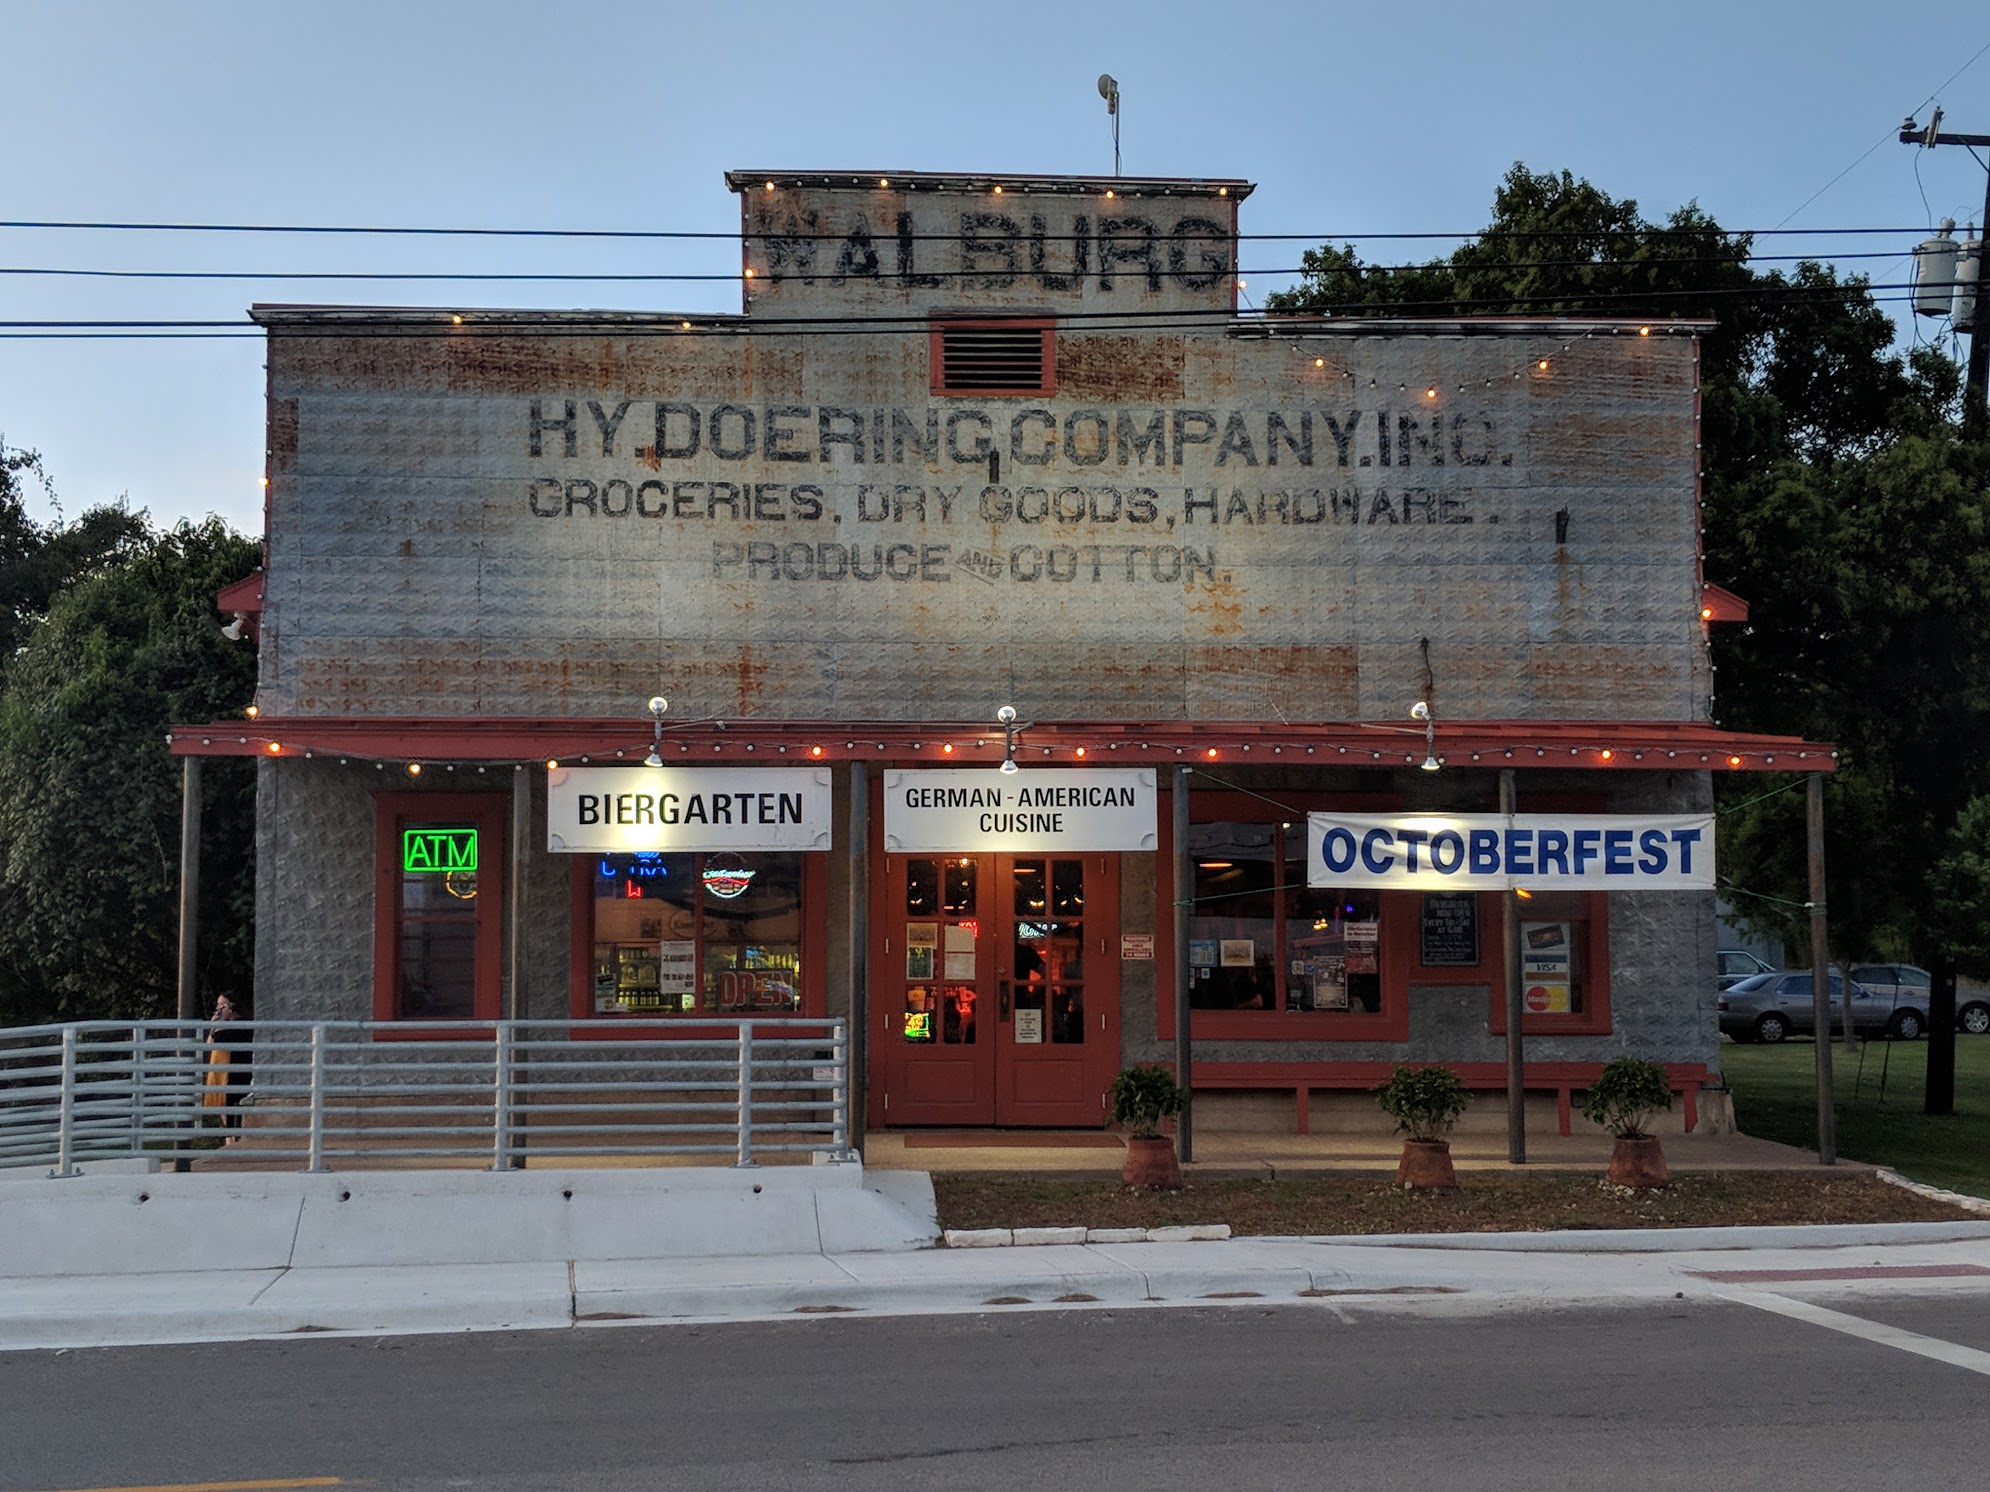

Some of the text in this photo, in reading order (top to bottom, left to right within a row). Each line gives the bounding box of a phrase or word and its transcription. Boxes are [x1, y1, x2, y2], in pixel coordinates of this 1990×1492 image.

[858, 483, 963, 523] DRY
[713, 540, 951, 583] PRODUCE
[578, 793, 803, 825] BIERGARTEN
[979, 813, 1064, 833] CUISINE
[408, 836, 474, 867] ATM
[1321, 827, 1702, 875] OCTOBERFEST
[1536, 963, 1557, 972] VISA
[718, 970, 794, 1007] OPEN
